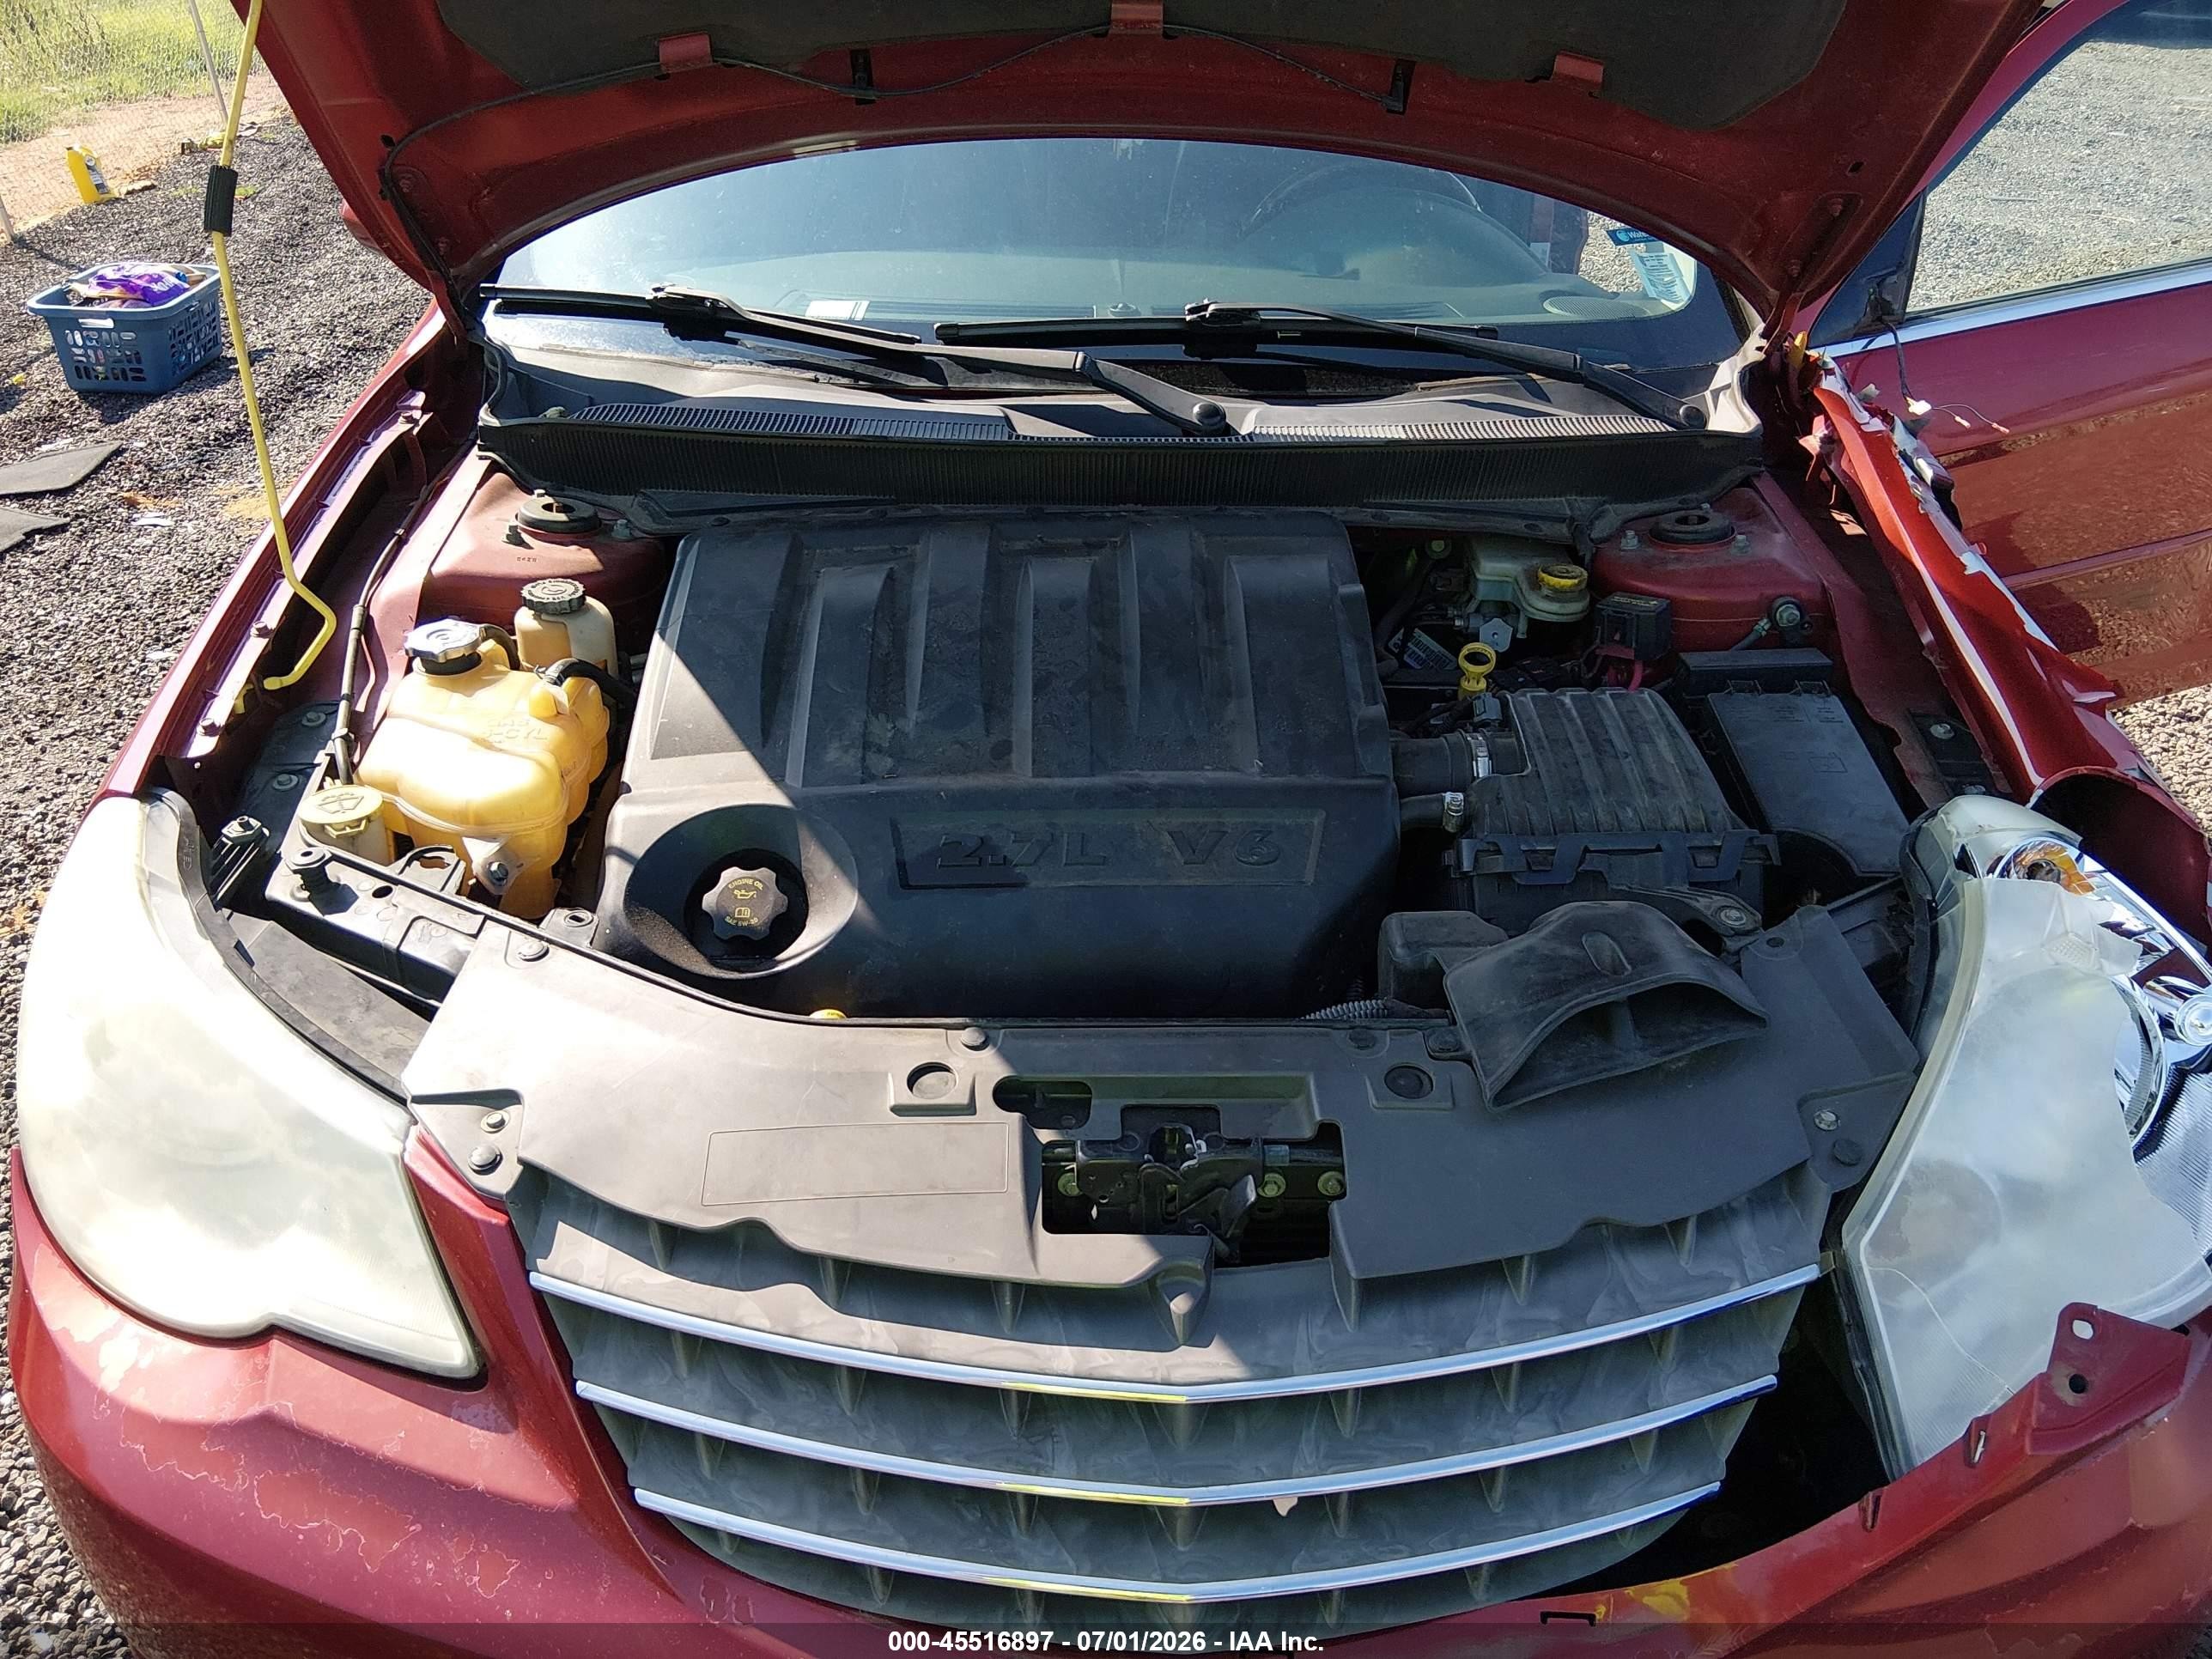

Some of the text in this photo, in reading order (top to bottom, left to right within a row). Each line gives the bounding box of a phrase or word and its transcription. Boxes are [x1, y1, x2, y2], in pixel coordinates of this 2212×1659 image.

[937, 829, 1281, 869] 2.7L V6
[728, 878, 763, 890] ENGINE OIL
